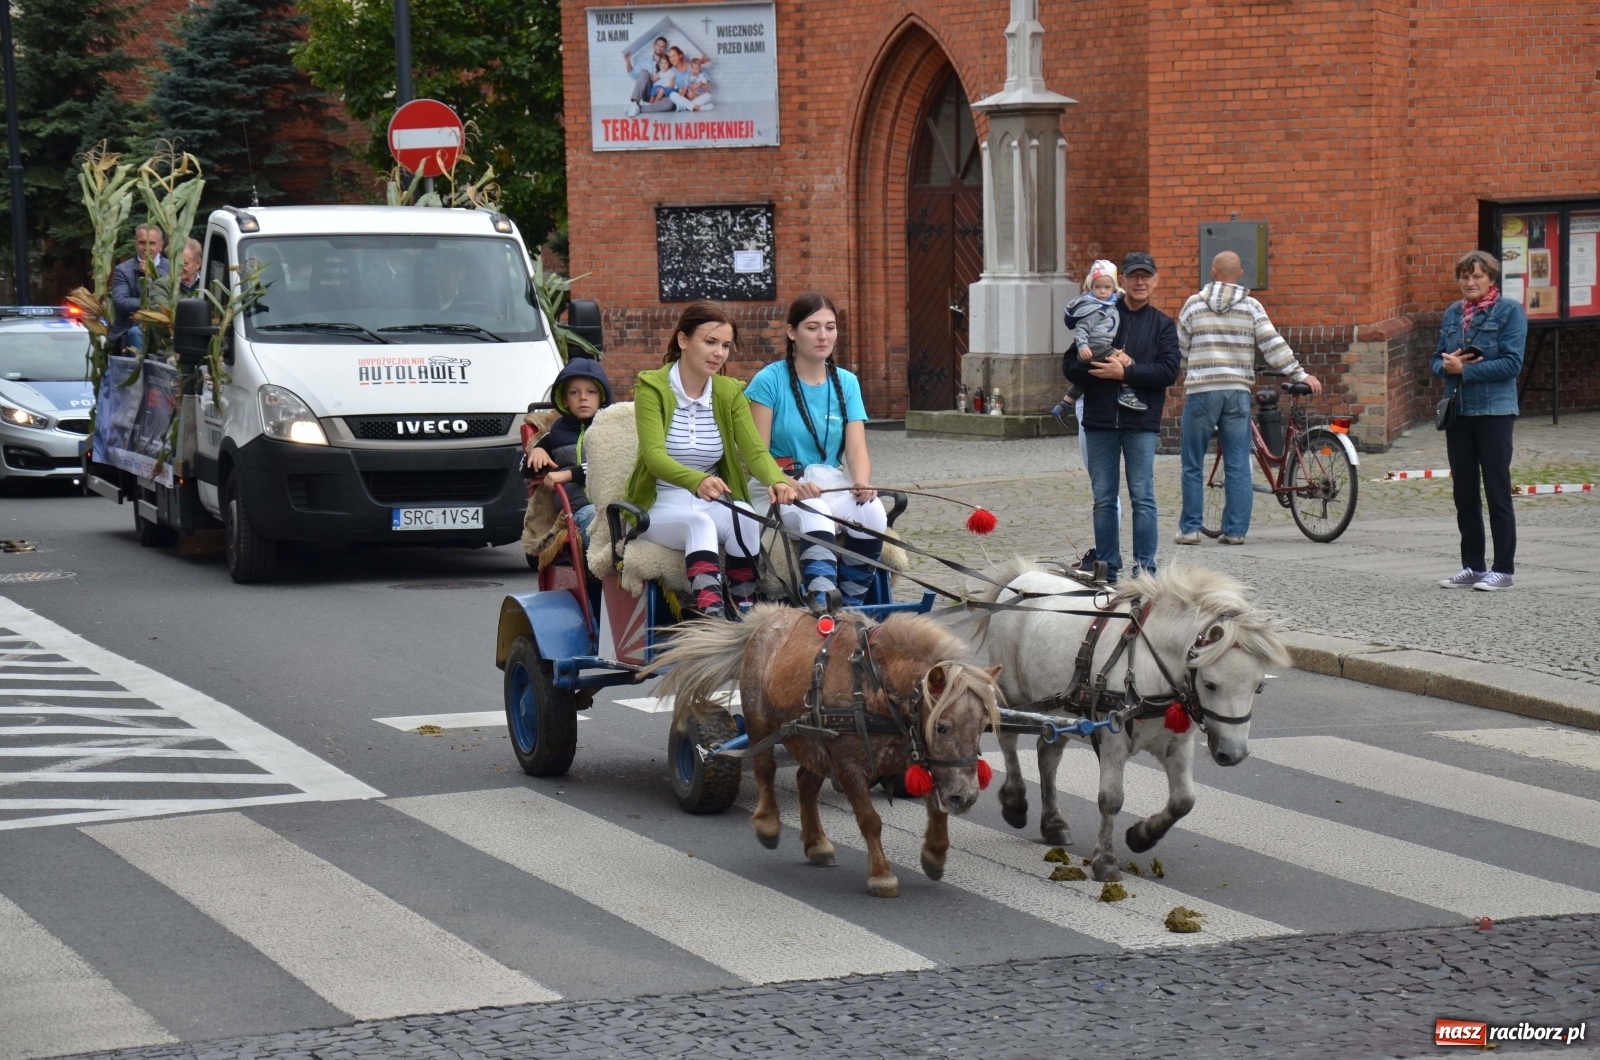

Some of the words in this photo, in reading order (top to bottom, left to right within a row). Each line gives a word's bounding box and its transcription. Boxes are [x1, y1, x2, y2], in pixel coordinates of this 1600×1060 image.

[596, 13, 634, 25] WAKACJE
[596, 30, 606, 42] ZA
[608, 29, 629, 42] NAMI
[716, 22, 764, 38] WIECZNOŚĆ
[717, 42, 742, 54] PRZED
[743, 40, 765, 53] NAMI
[601, 118, 649, 142] TERAZ
[653, 120, 672, 141] ŻYJ
[675, 120, 754, 142] NAJPIĘKNIEJ!
[358, 356, 425, 366] WYPOŻYCZALNIA
[358, 365, 467, 382] AUTOLAWET
[396, 419, 469, 435] IVECO
[403, 509, 434, 526] SRC
[441, 508, 480, 525] 1VS4
